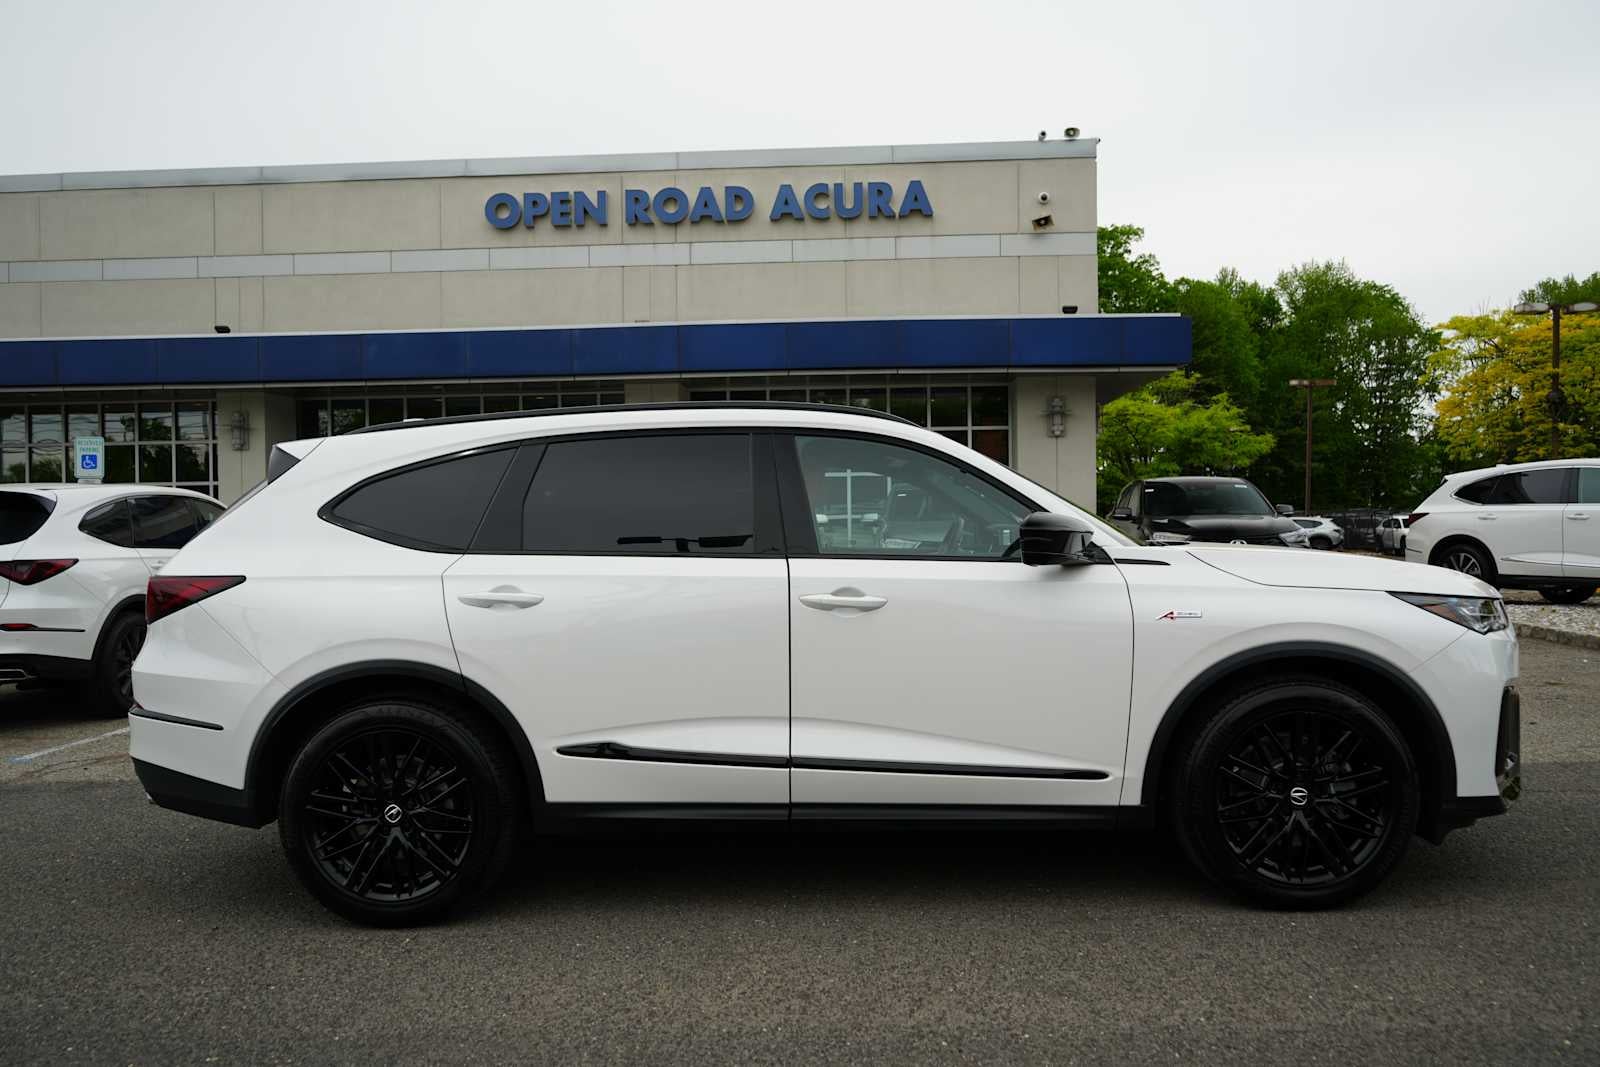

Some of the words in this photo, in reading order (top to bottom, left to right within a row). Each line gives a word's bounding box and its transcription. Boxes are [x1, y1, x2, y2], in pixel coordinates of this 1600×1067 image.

[485, 190, 608, 229] OPEN
[625, 186, 754, 225] ROAD
[769, 180, 934, 222] ACURA
